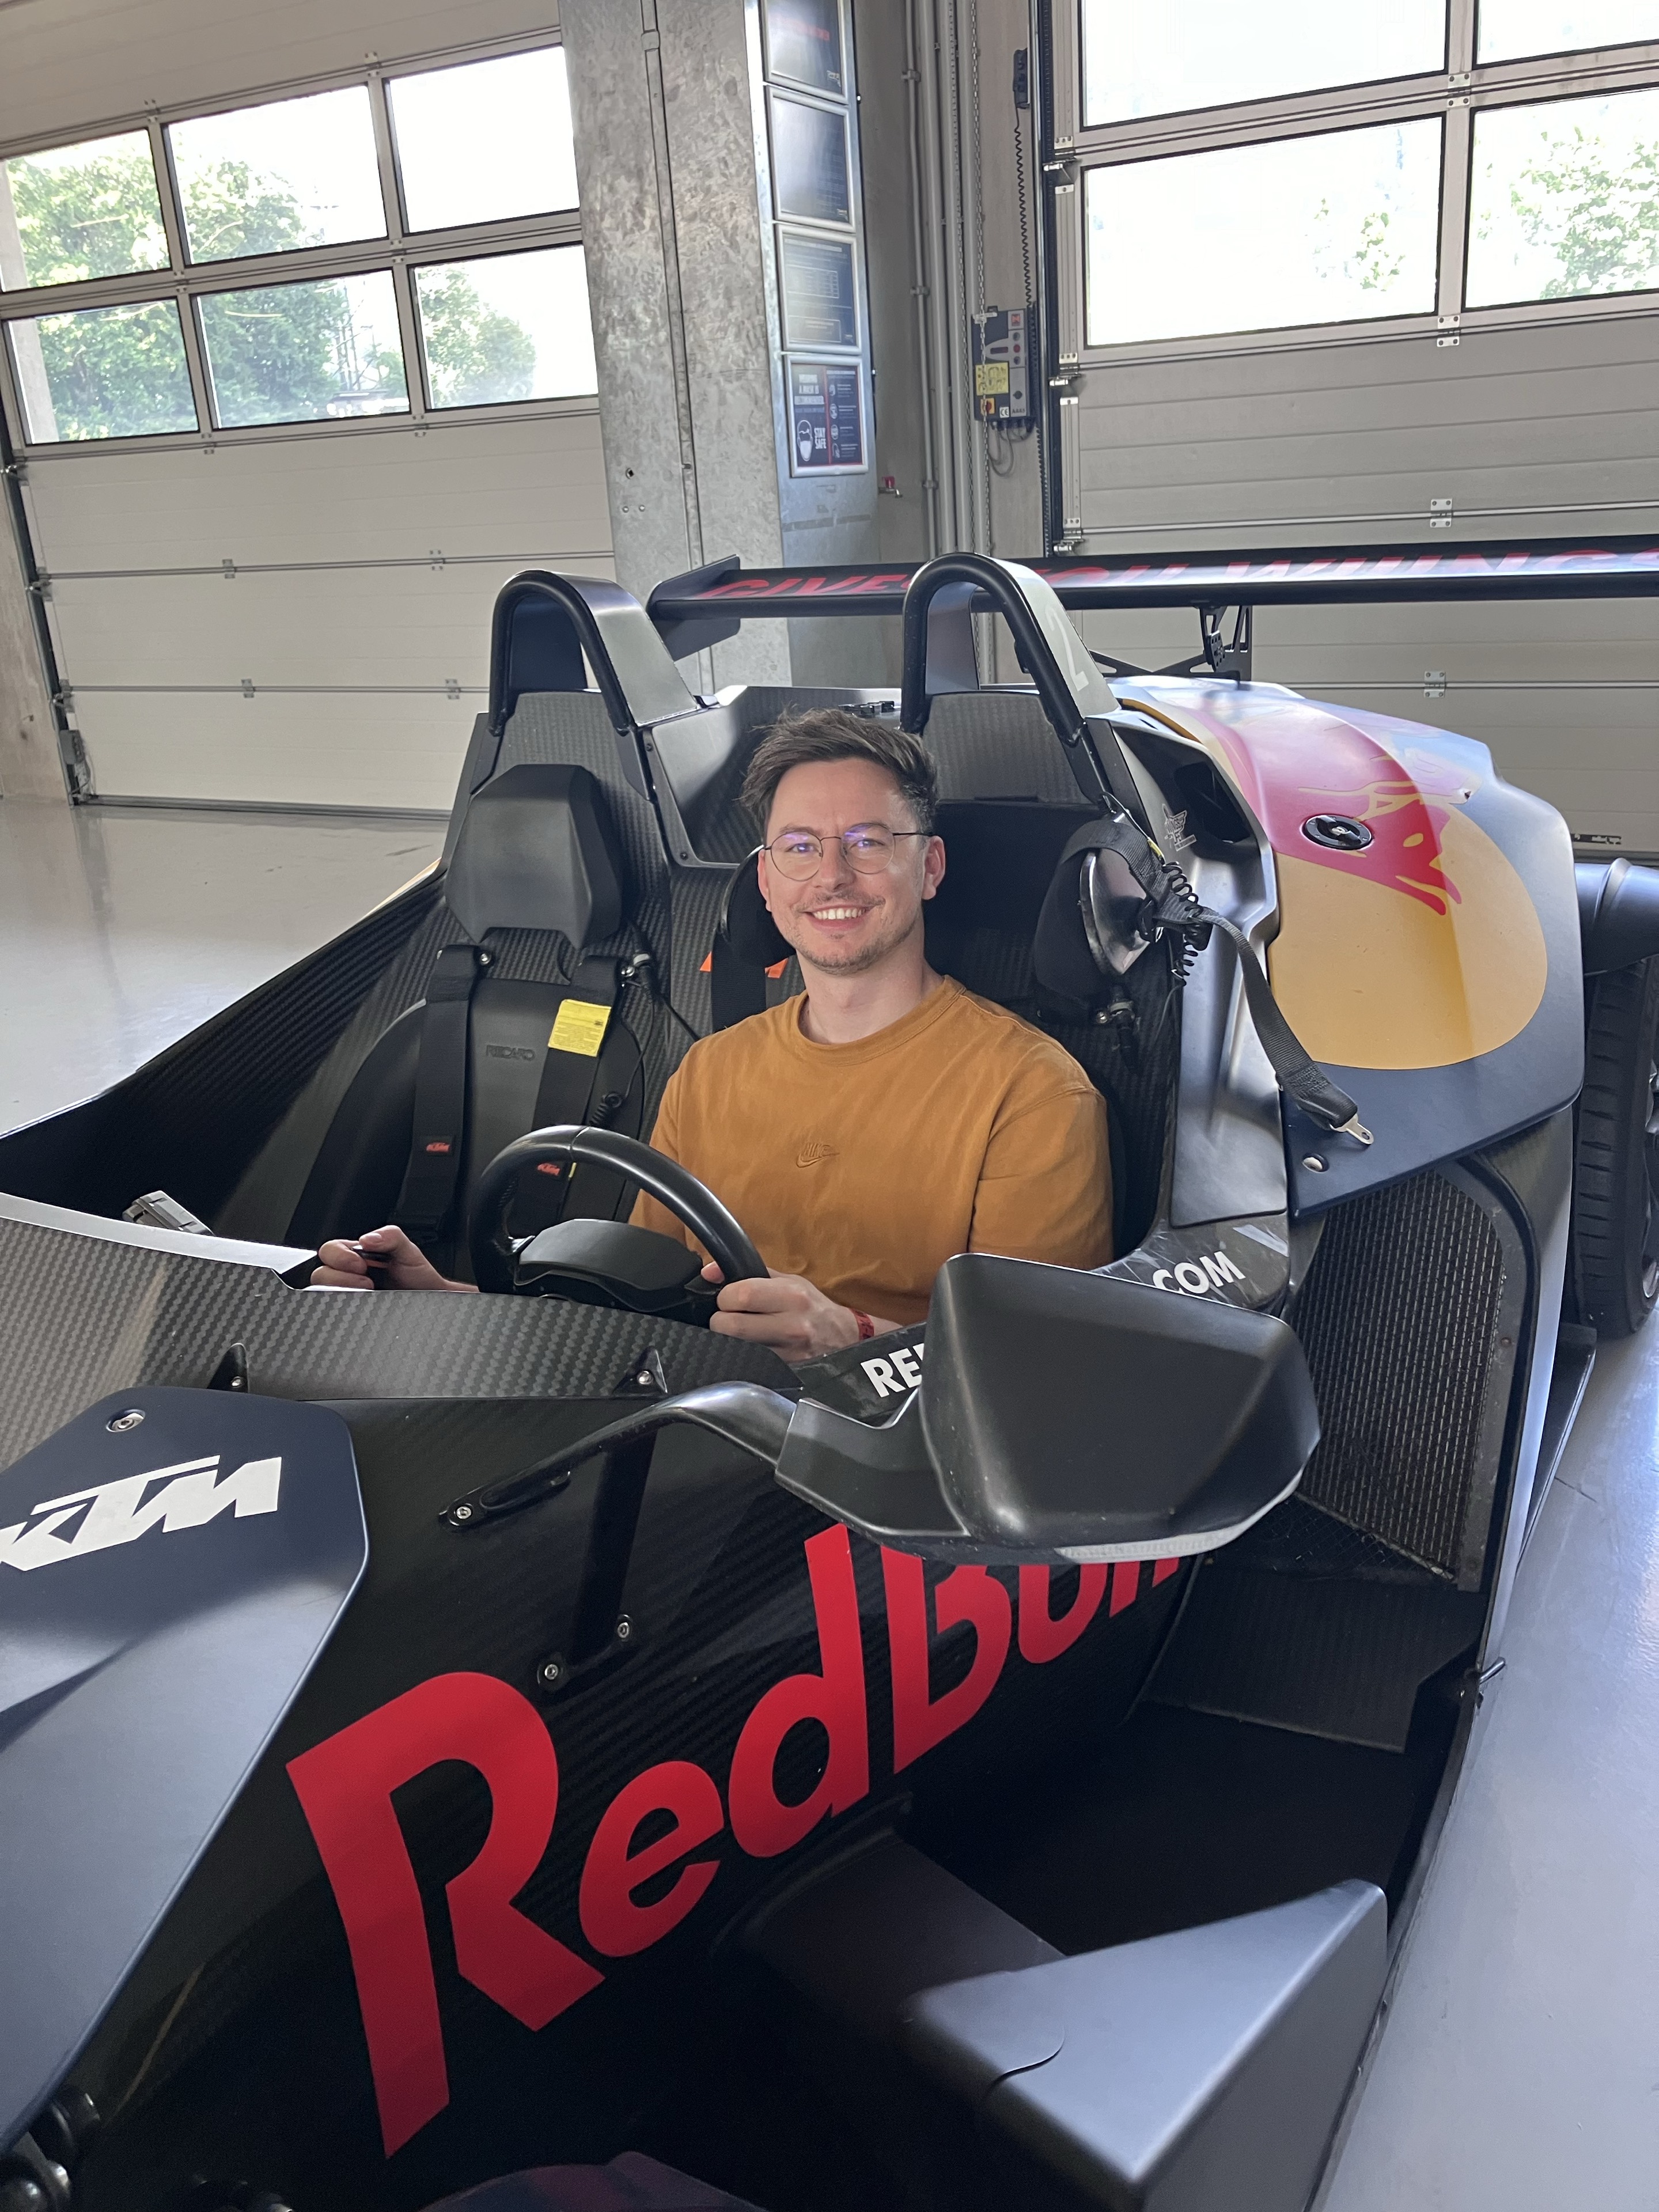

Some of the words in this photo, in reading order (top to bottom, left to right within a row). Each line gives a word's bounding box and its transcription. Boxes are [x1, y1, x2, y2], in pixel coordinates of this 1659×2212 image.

[815, 438, 827, 449] SAFE
[696, 574, 911, 599] GIVE
[1034, 562, 1189, 585] OU
[486, 1044, 536, 1061] RECARO
[426, 1142, 450, 1153] KTM
[803, 1142, 833, 1157] NIKE
[537, 1162, 560, 1176] KTM
[860, 1343, 924, 1398] RE
[0, 1455, 282, 1571] KTM
